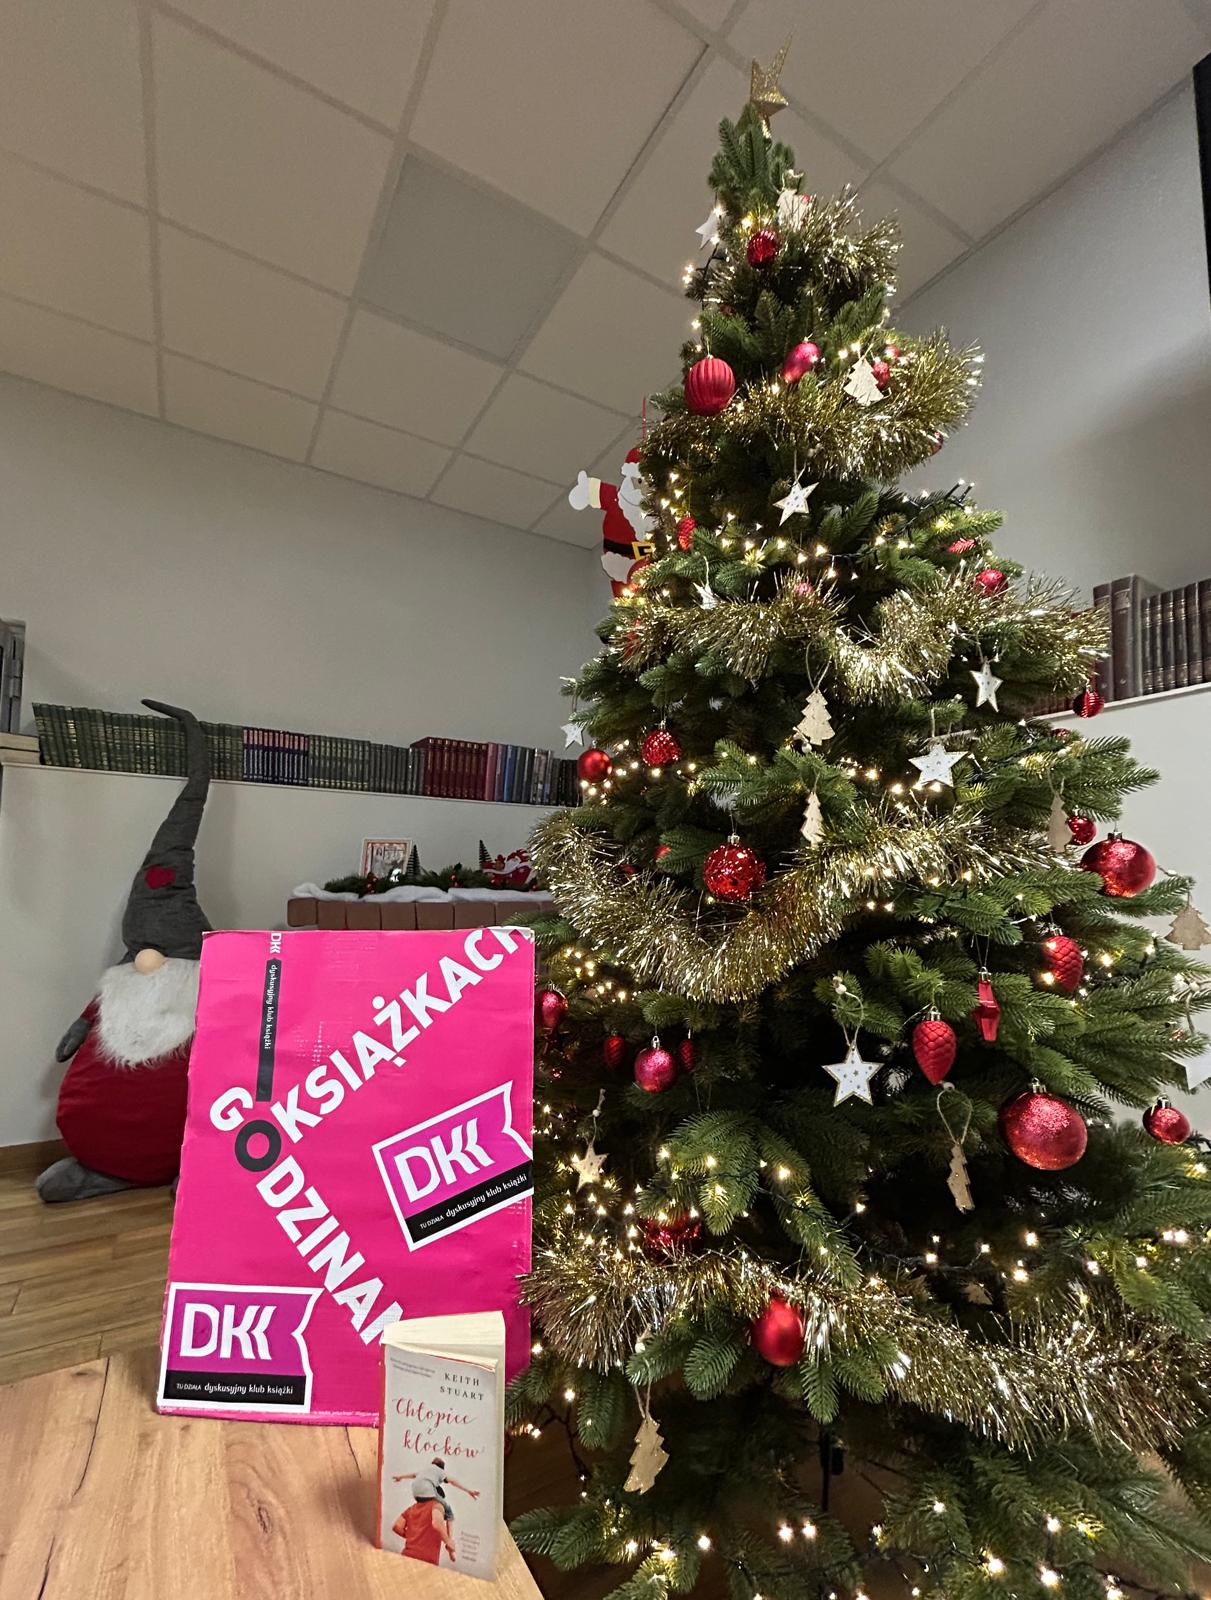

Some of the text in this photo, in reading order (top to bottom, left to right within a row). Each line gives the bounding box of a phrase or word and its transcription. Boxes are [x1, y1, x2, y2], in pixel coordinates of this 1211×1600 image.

[264, 964, 278, 1050] dyskusyjny klub książki
[420, 1221, 428, 1229] TU
[446, 1194, 486, 1218] dyskusyjny
[486, 1185, 502, 1199] klub
[502, 1173, 527, 1191] książki
[204, 1383, 247, 1395] dyskusyjny
[249, 1384, 265, 1393] klub
[267, 1385, 294, 1396] książki
[444, 1372, 480, 1386] KEITH
[440, 1386, 485, 1401] STUART
[403, 1429, 481, 1458] klocków
